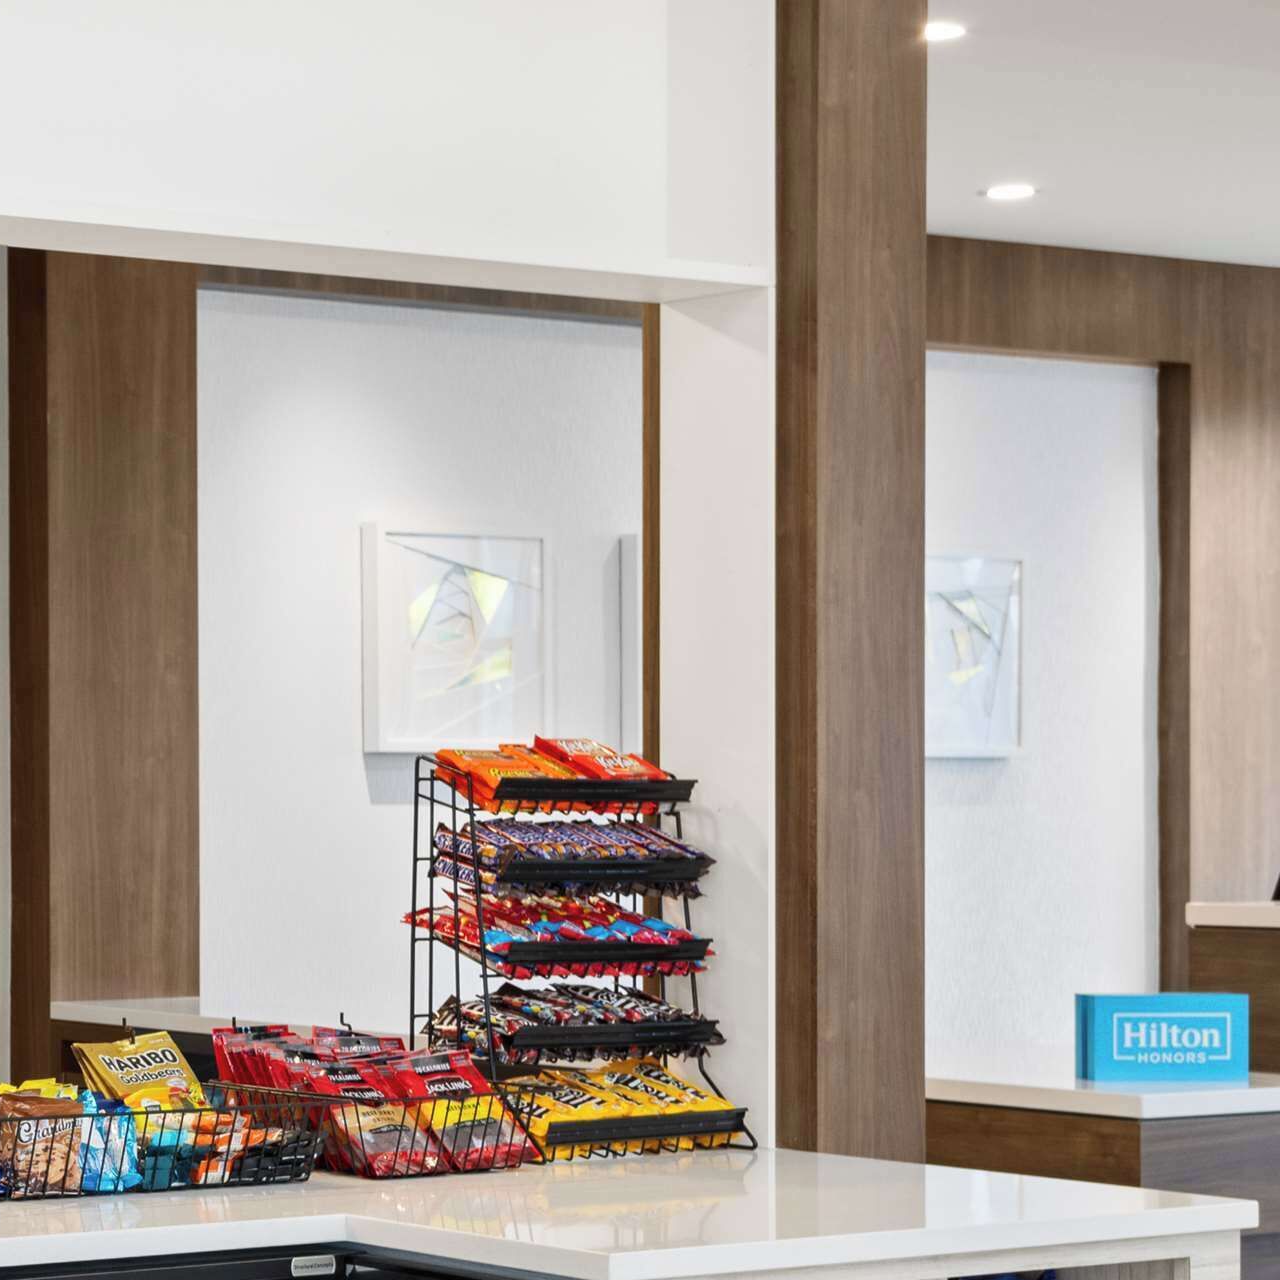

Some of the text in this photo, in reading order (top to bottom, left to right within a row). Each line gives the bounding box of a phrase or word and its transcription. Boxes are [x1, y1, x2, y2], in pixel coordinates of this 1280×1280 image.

[1123, 1022, 1220, 1048] Hilton
[101, 1048, 180, 1073] HARIBO
[1137, 1052, 1207, 1064] HONORS
[120, 1067, 184, 1086] Goldbears
[340, 1088, 360, 1098] JACK
[425, 1082, 445, 1094] JACK
